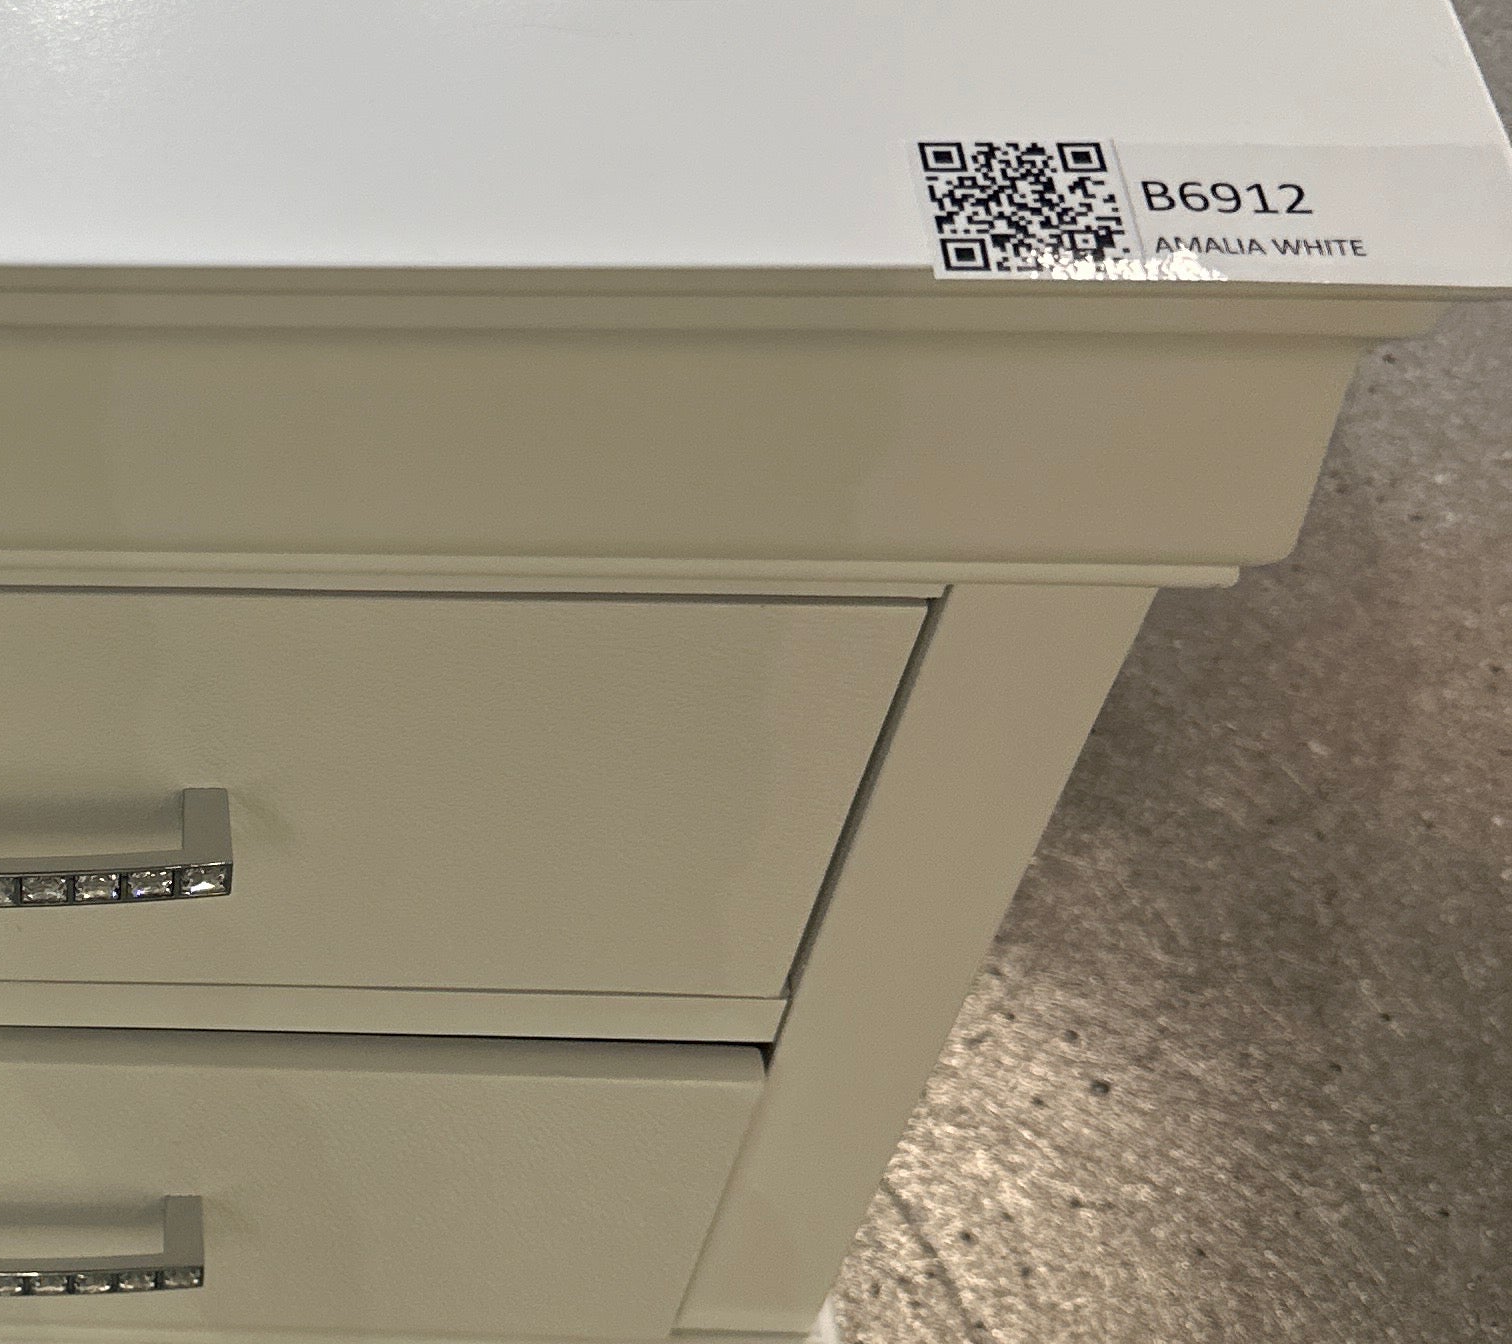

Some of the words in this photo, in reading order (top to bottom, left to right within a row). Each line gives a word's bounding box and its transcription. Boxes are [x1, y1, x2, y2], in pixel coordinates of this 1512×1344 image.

[1141, 181, 1313, 214] B6912
[1155, 236, 1266, 255] AMALIA
[1271, 239, 1367, 257] WHITE
